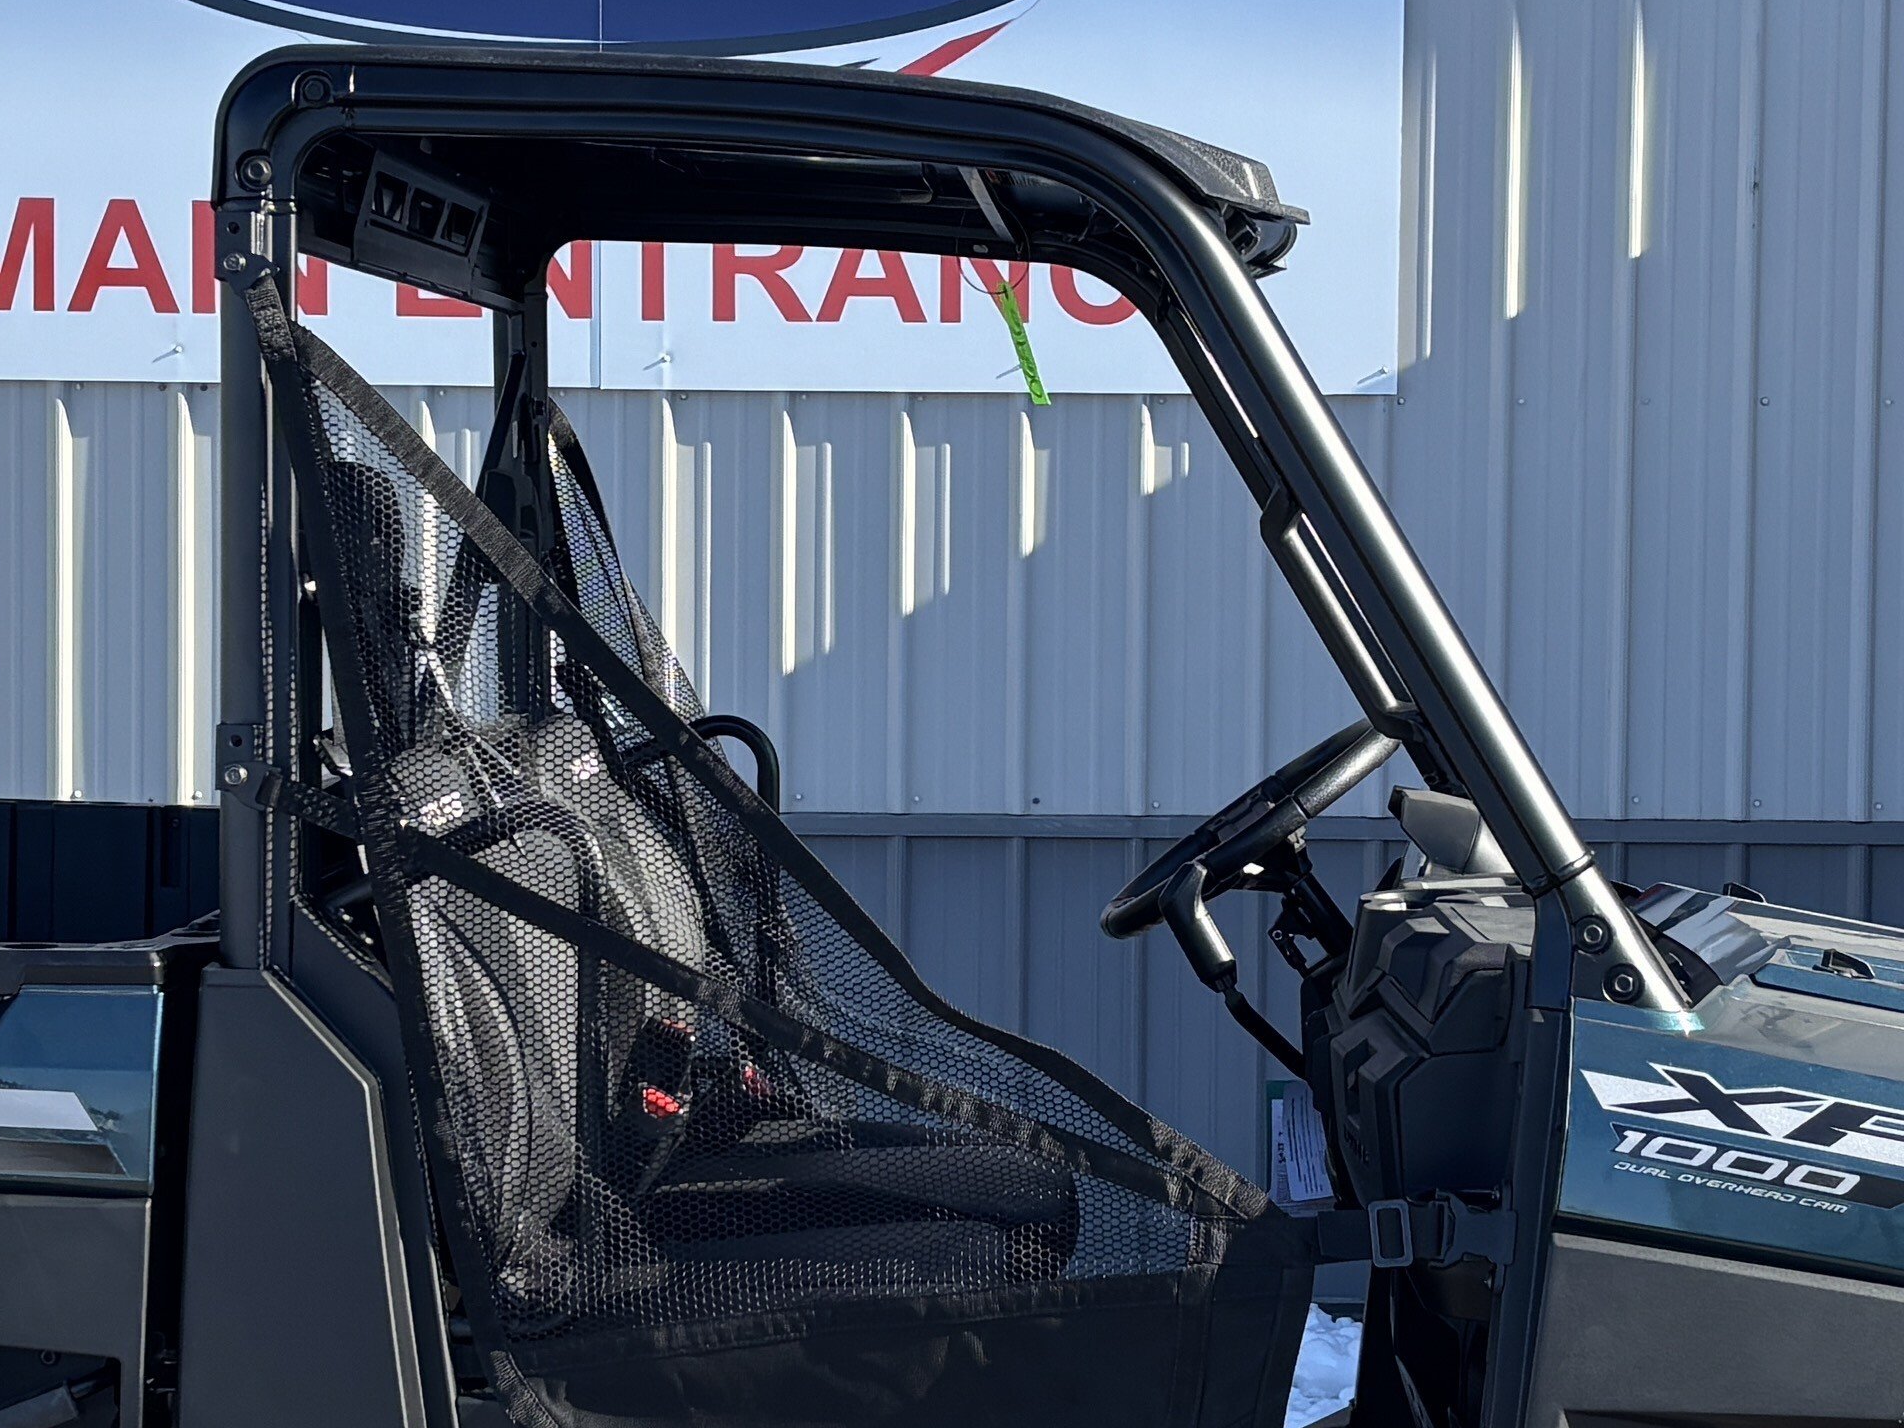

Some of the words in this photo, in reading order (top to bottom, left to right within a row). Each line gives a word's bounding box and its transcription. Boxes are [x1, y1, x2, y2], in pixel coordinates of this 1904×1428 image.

[1611, 1128, 1862, 1196] 1000
[1612, 1160, 1673, 1181] DUAL
[1677, 1172, 1796, 1204] OVERHEAD
[1798, 1196, 1850, 1215] CAM
